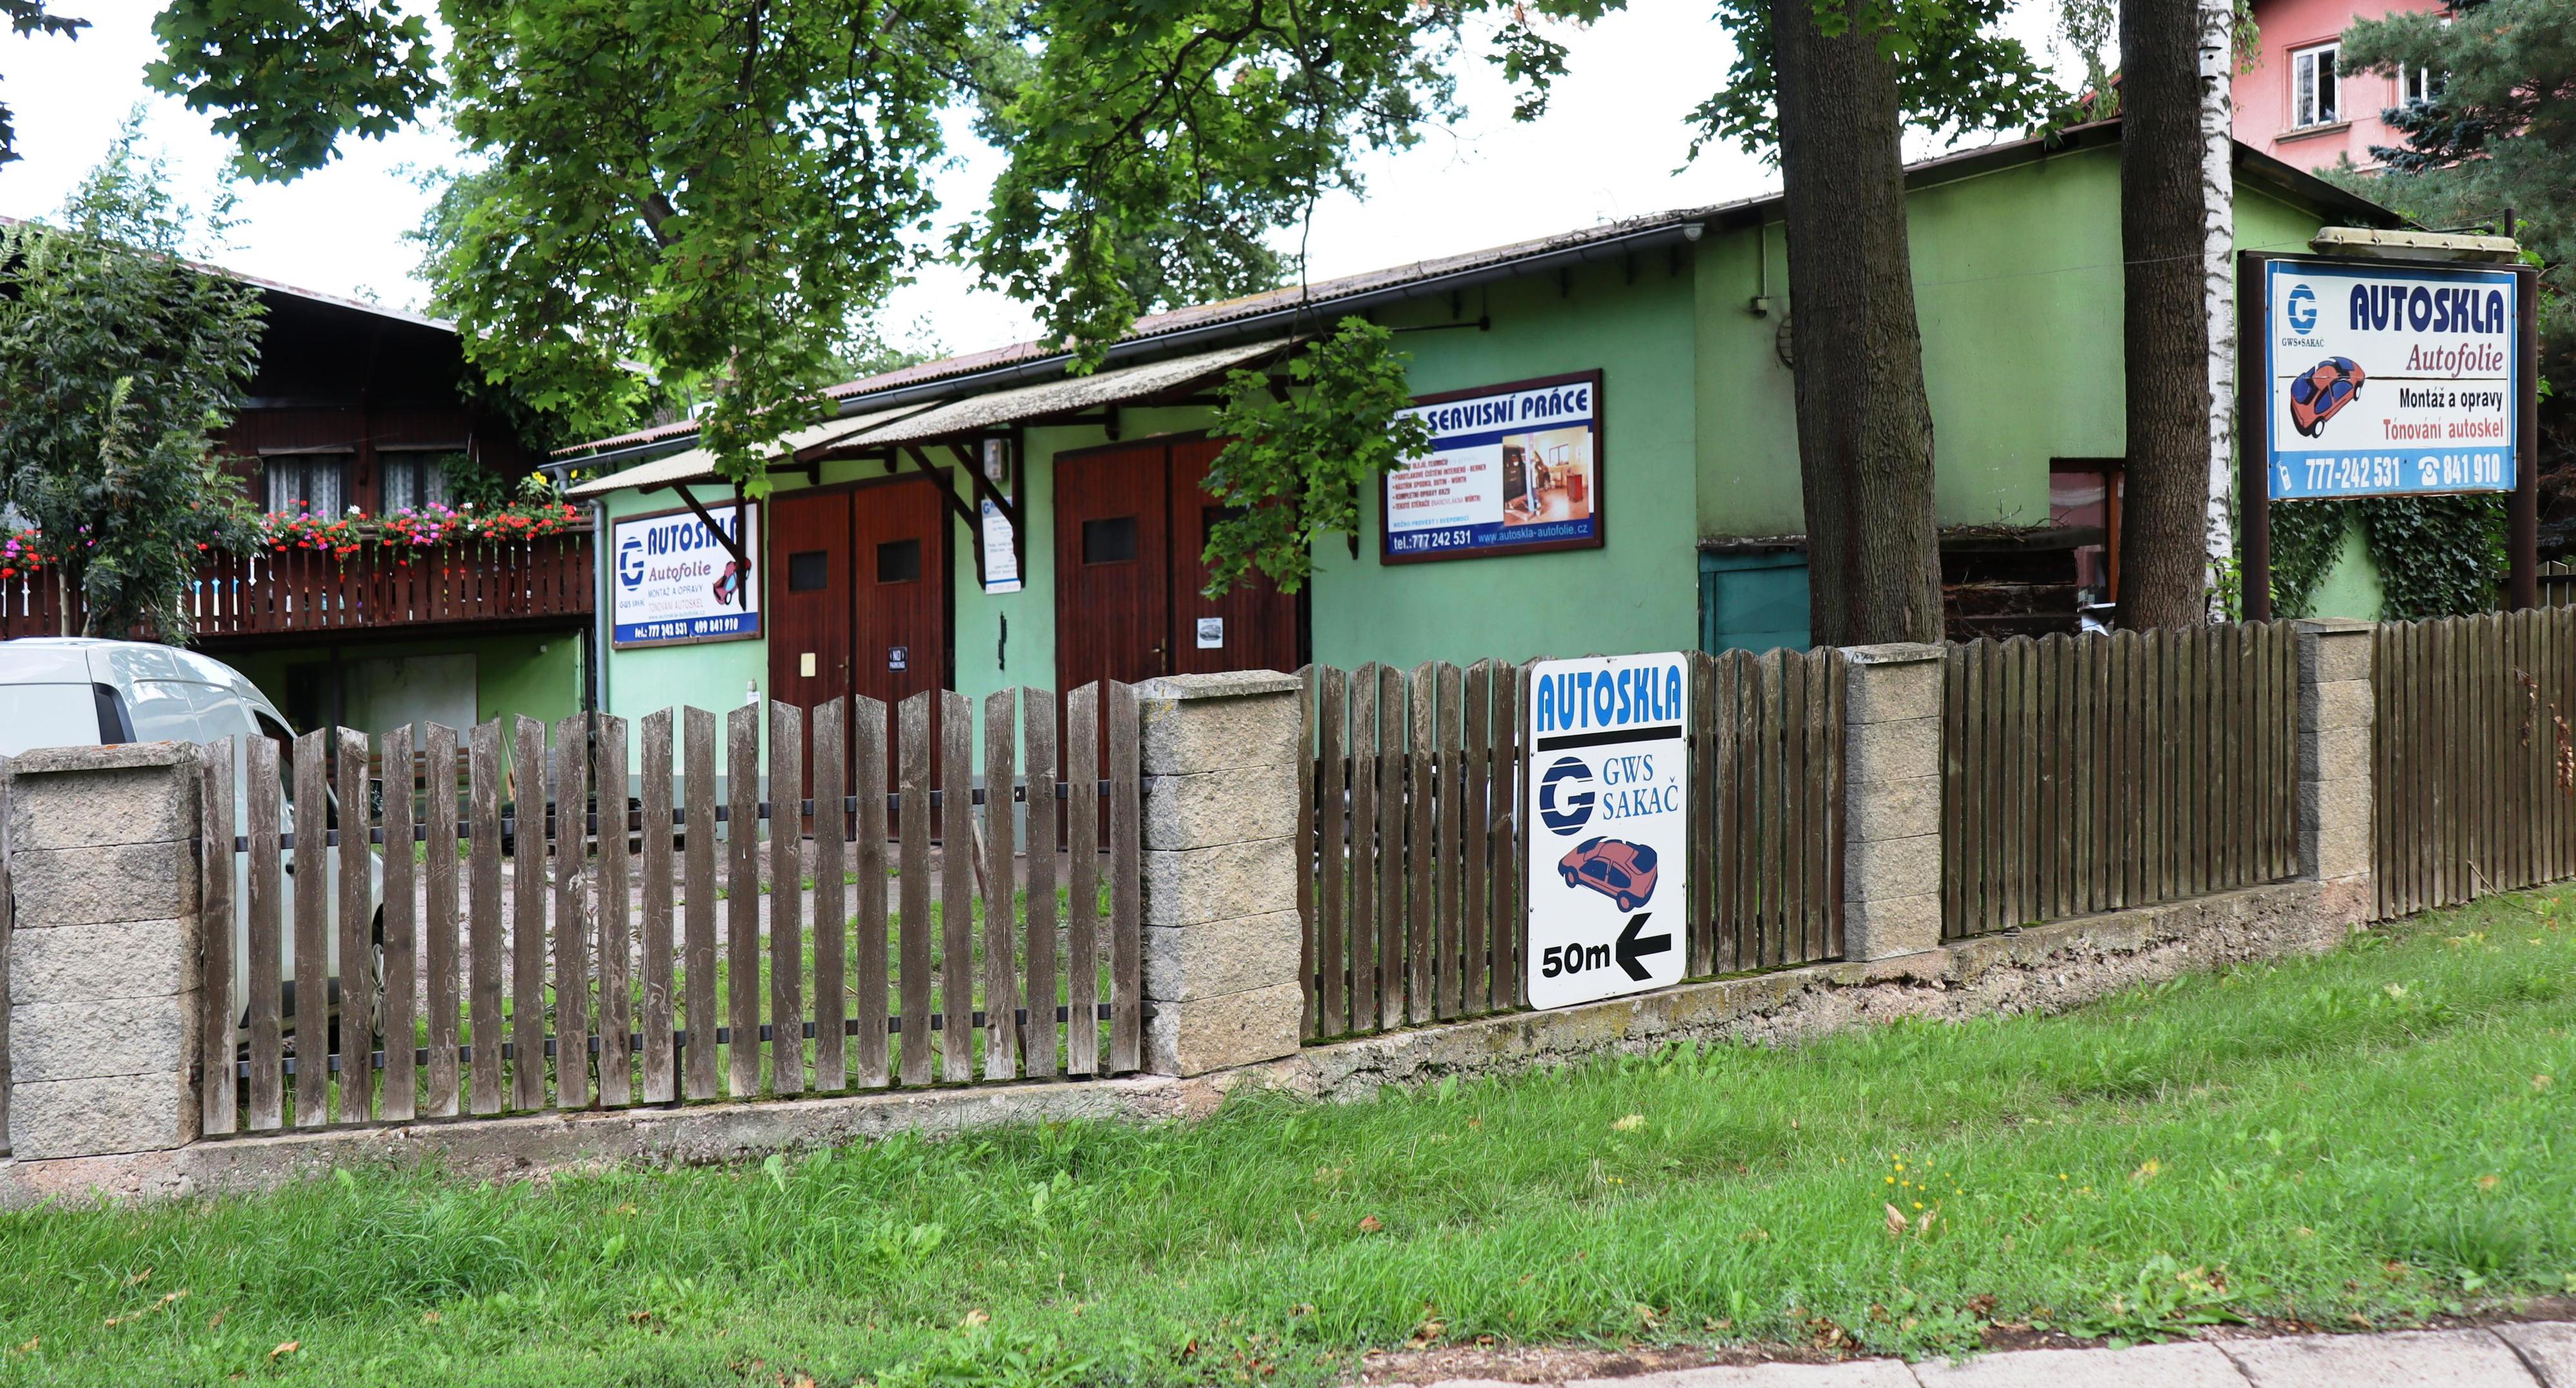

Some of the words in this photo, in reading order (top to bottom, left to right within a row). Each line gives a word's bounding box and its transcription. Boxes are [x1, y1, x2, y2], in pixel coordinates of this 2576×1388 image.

[2350, 283, 2505, 334] AUTOSKLA
[2406, 343, 2503, 378] Autofolie
[1428, 395, 1515, 432] SERVISNÍ
[1522, 388, 1587, 419] PRÁCE
[2400, 387, 2445, 408] Montáž
[2448, 393, 2456, 408] a
[2460, 390, 2503, 413] opravy
[2383, 417, 2441, 440] Tónování
[2448, 418, 2503, 438] autoskel
[2306, 458, 2370, 490] 777-242
[2374, 456, 2400, 487] 531
[2443, 454, 2469, 484] 841
[2473, 453, 2500, 483] 910
[1432, 532, 1450, 547] 242
[1454, 530, 1470, 545] 531
[649, 560, 711, 583] Autofolie
[649, 624, 660, 637] 777
[661, 623, 674, 636] 242
[675, 622, 687, 635] 531
[694, 620, 708, 633] 499
[710, 619, 723, 633] 841
[724, 617, 739, 632] 910
[893, 650, 901, 661] NO
[1537, 665, 1681, 732] AUTOSKLA
[1603, 755, 1653, 785] GWS
[1602, 776, 1679, 821] SAKAČ
[1542, 942, 1611, 978] 50m
